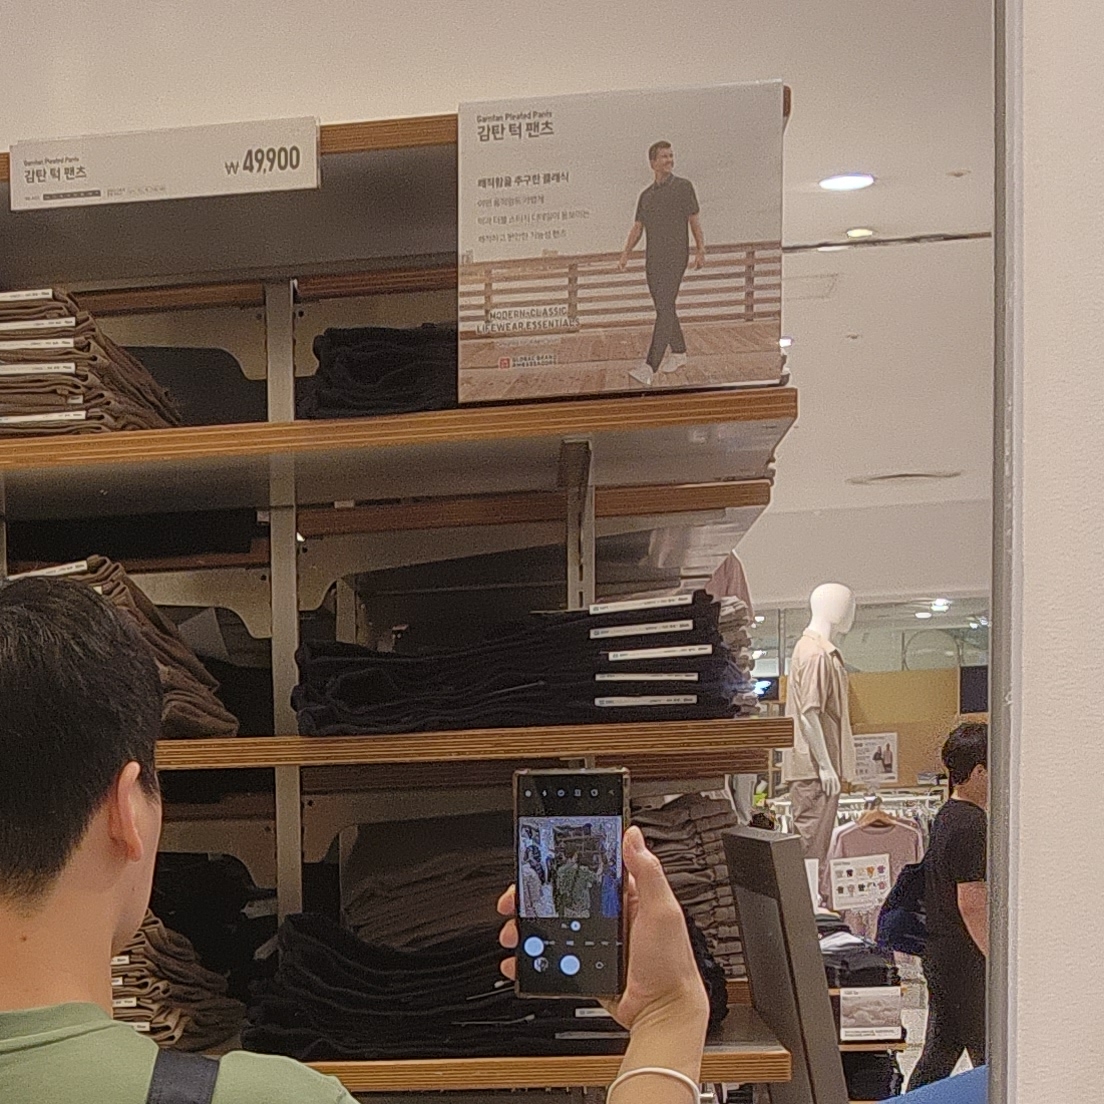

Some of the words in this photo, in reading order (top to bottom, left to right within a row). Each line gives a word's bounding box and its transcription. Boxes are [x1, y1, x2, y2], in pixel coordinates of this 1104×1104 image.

[532, 110, 553, 119] Pants
[477, 123, 505, 142] 감탄
[508, 122, 522, 139] 턱
[525, 120, 555, 138] 팬츠
[24, 167, 46, 183] 감탄
[49, 167, 61, 181] 턱
[64, 165, 87, 180] 팬츠
